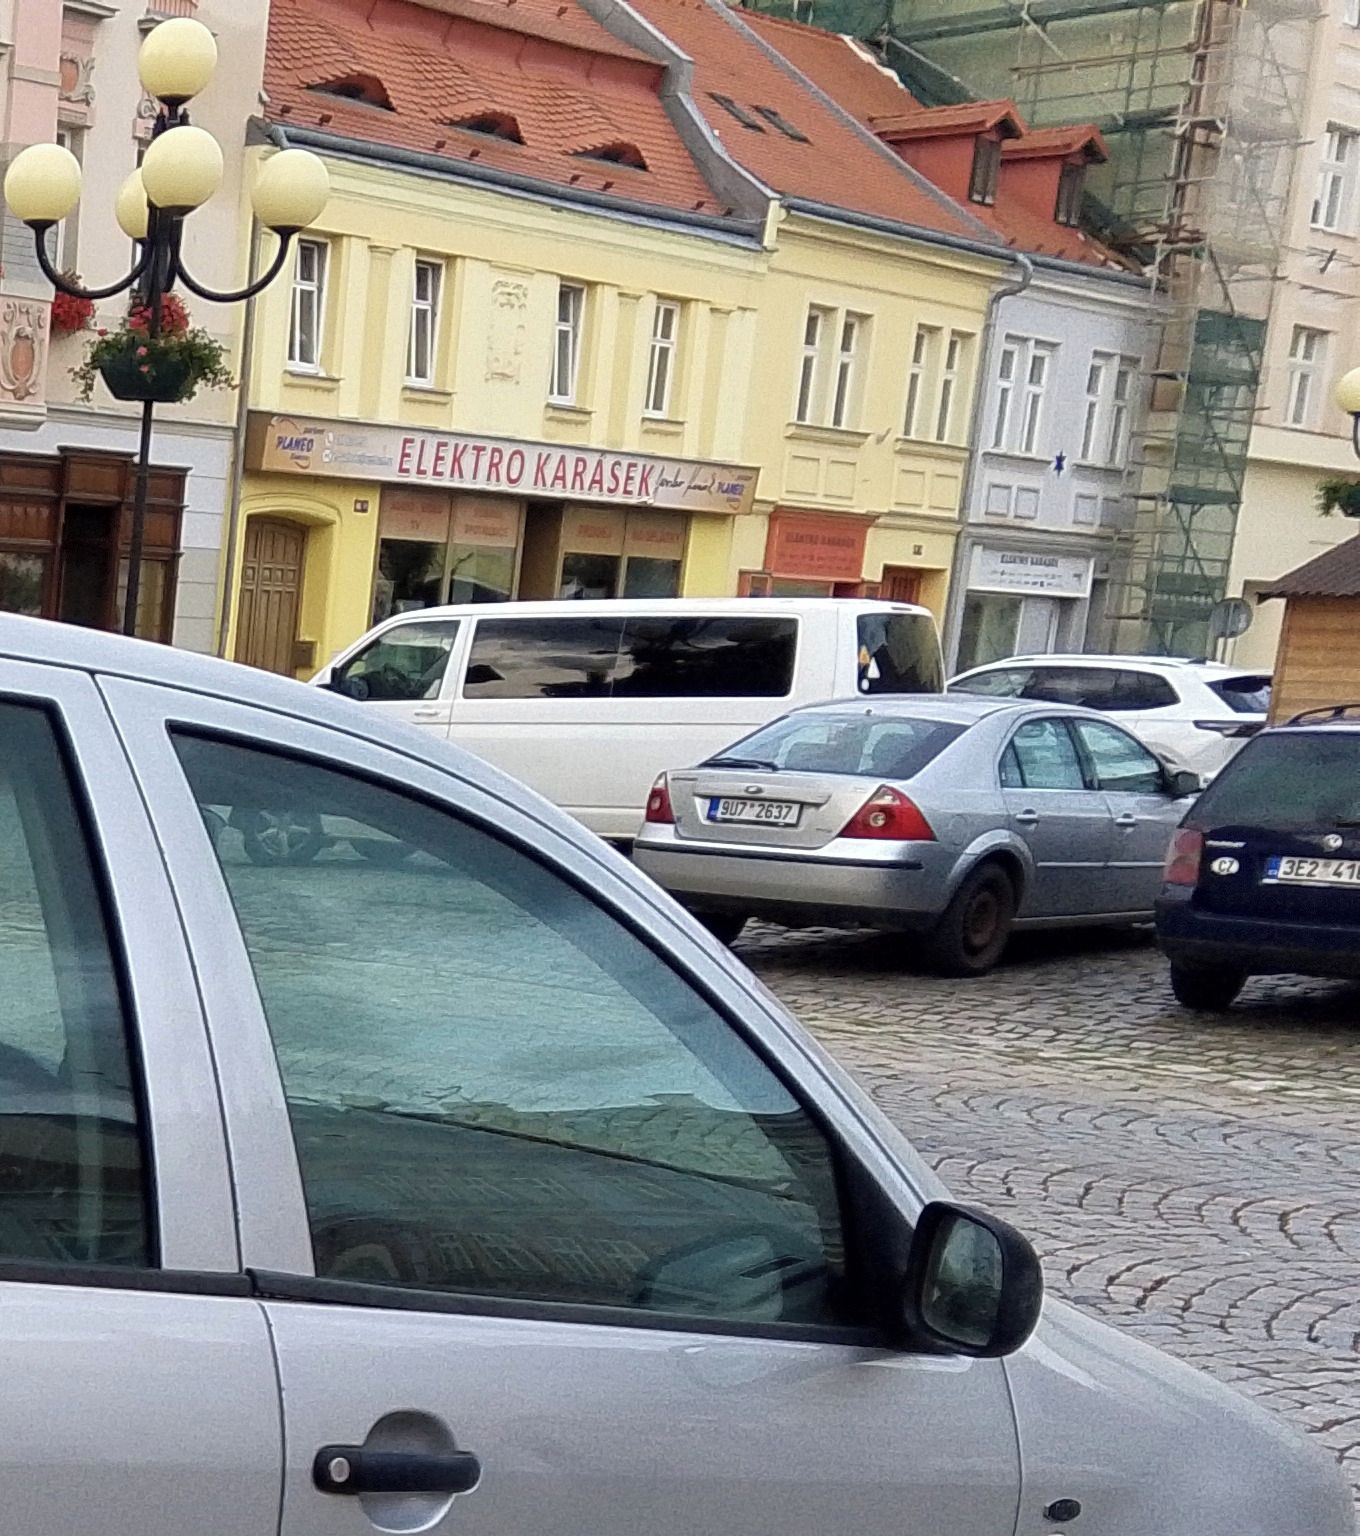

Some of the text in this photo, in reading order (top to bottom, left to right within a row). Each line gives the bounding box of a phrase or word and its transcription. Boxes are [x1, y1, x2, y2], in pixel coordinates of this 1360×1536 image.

[276, 436, 314, 451] PLANEO
[397, 437, 526, 485] ELEKTRO
[533, 452, 656, 497] KARÁSEK
[720, 801, 793, 821] 9U7 2637
[1283, 859, 1320, 878] 3E2
